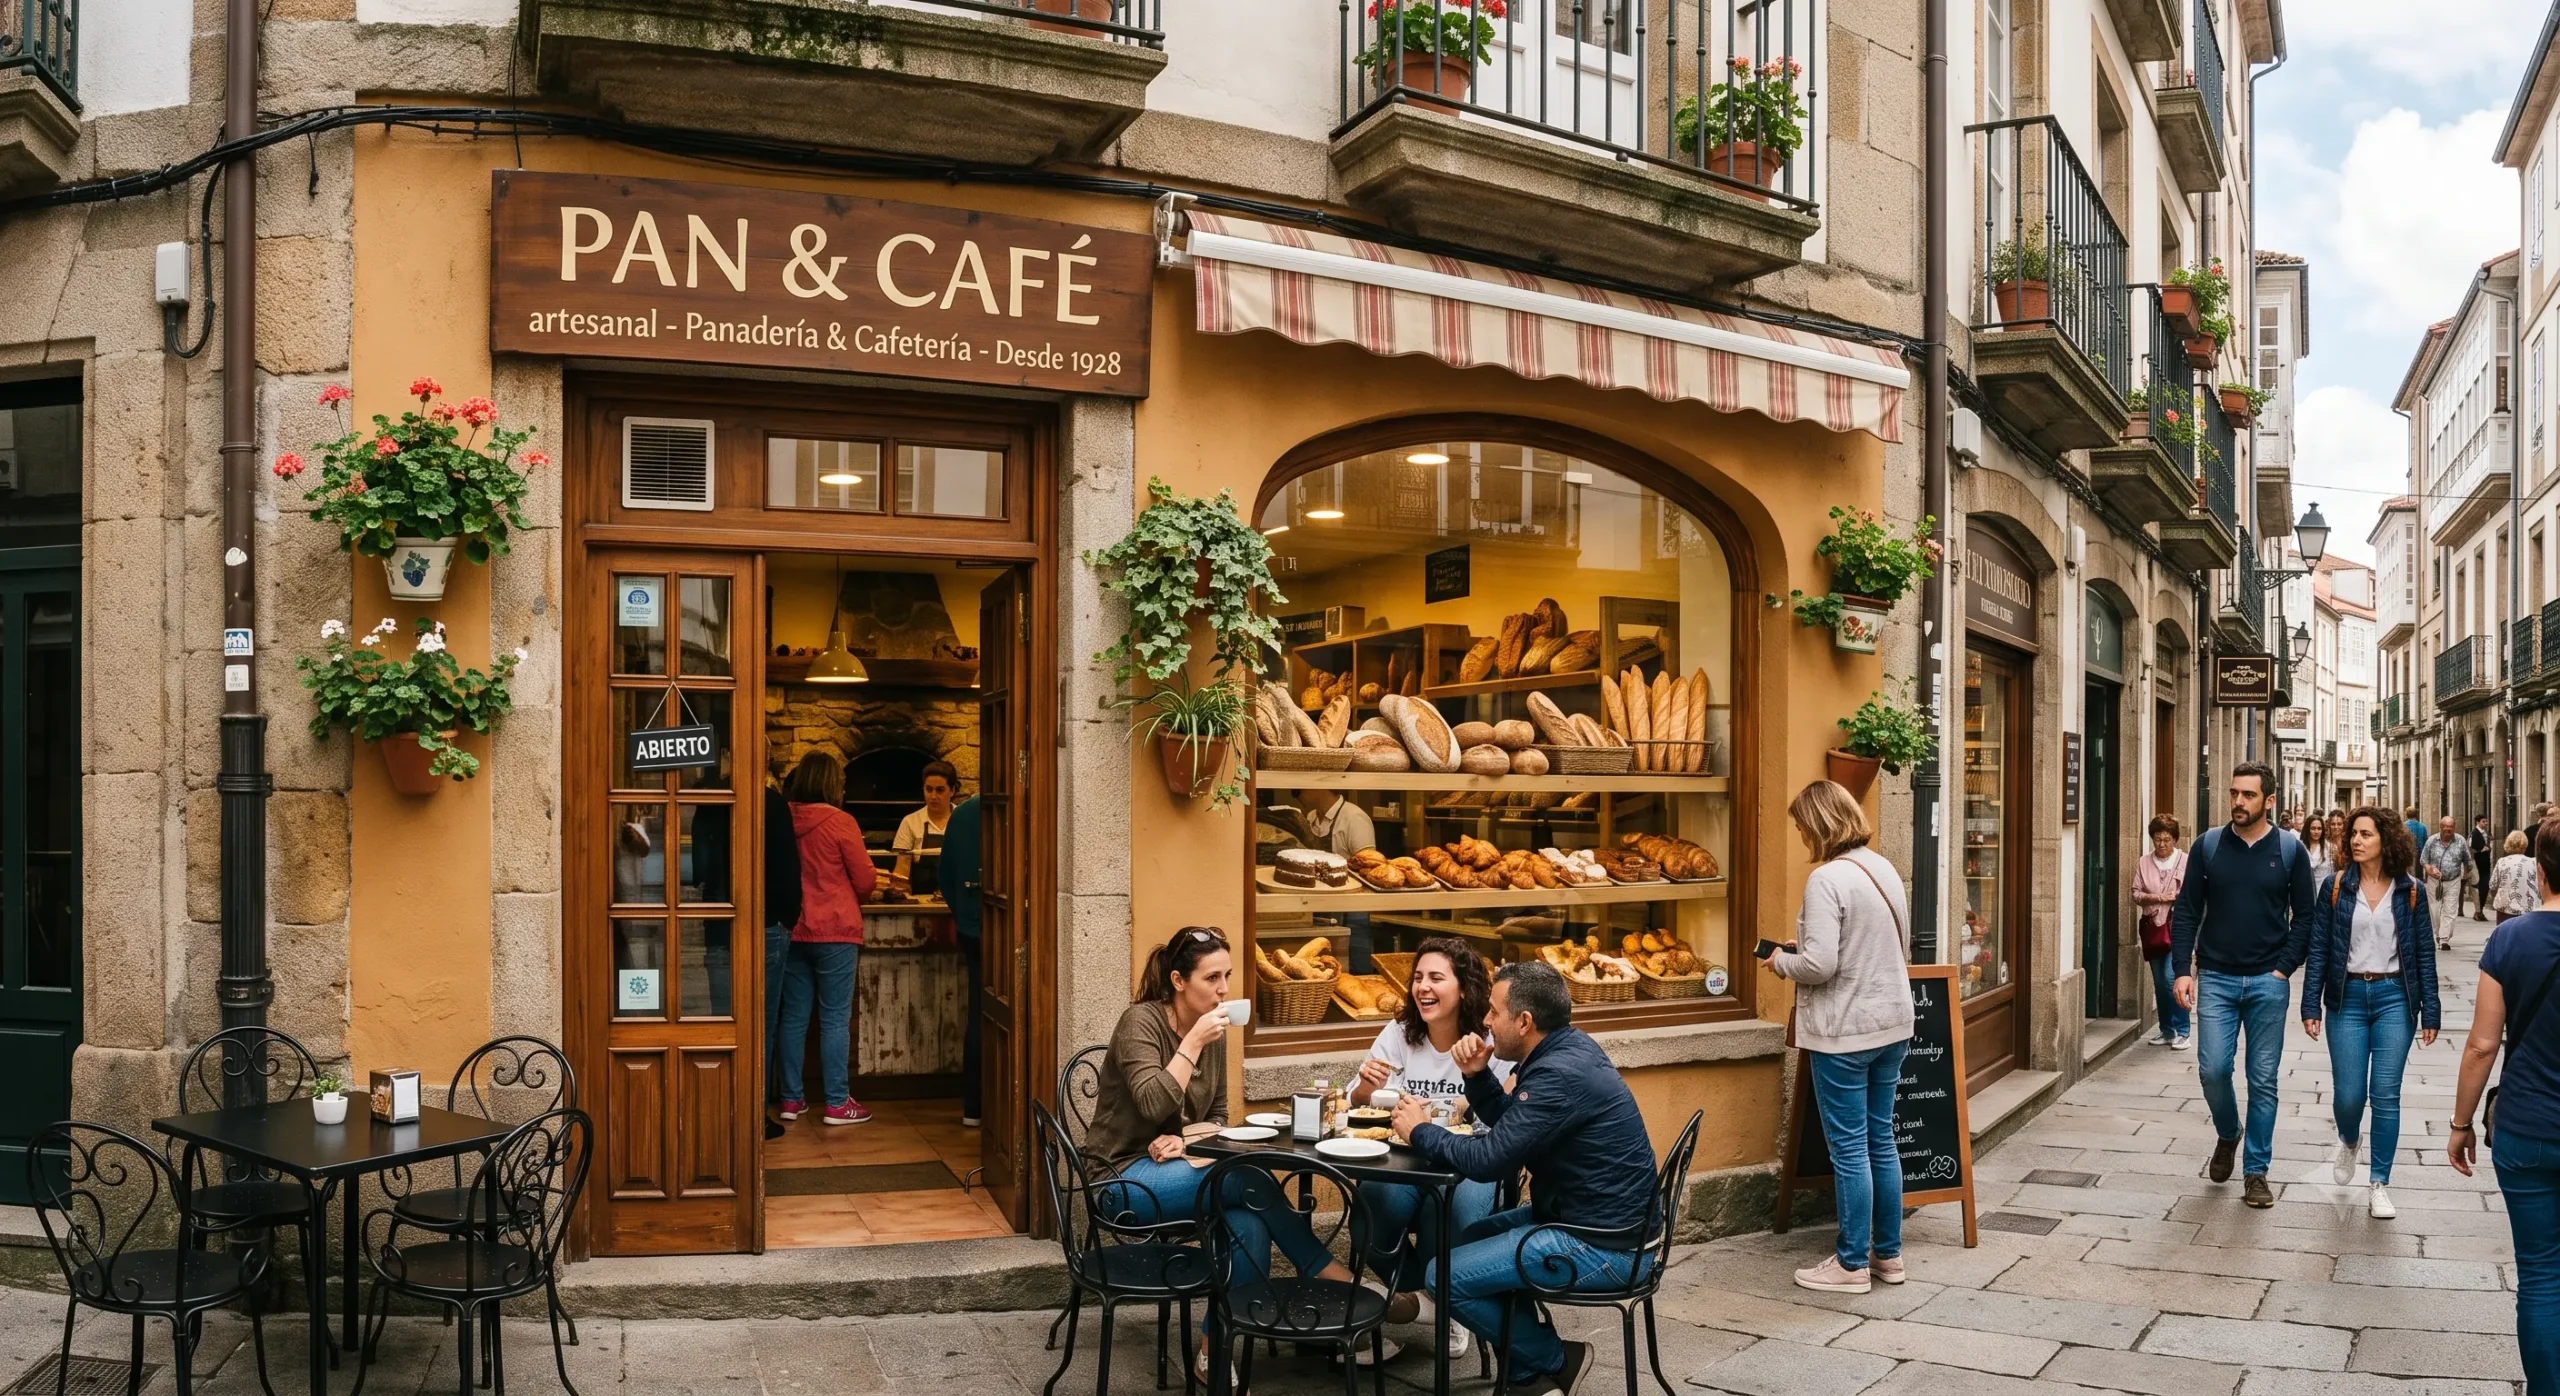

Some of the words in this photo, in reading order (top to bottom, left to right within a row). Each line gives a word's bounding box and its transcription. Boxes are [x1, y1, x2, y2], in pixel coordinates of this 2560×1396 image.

[560, 206, 749, 292] PAN
[781, 223, 849, 301] &
[876, 233, 1100, 326] CAFÉ
[528, 308, 658, 339] artesanal
[686, 312, 820, 350] Panadería
[826, 321, 848, 351] &
[854, 324, 972, 362] Cafetería
[995, 339, 1064, 370] Desde
[1070, 351, 1122, 377] 1928
[635, 735, 711, 761] ABIERTO
